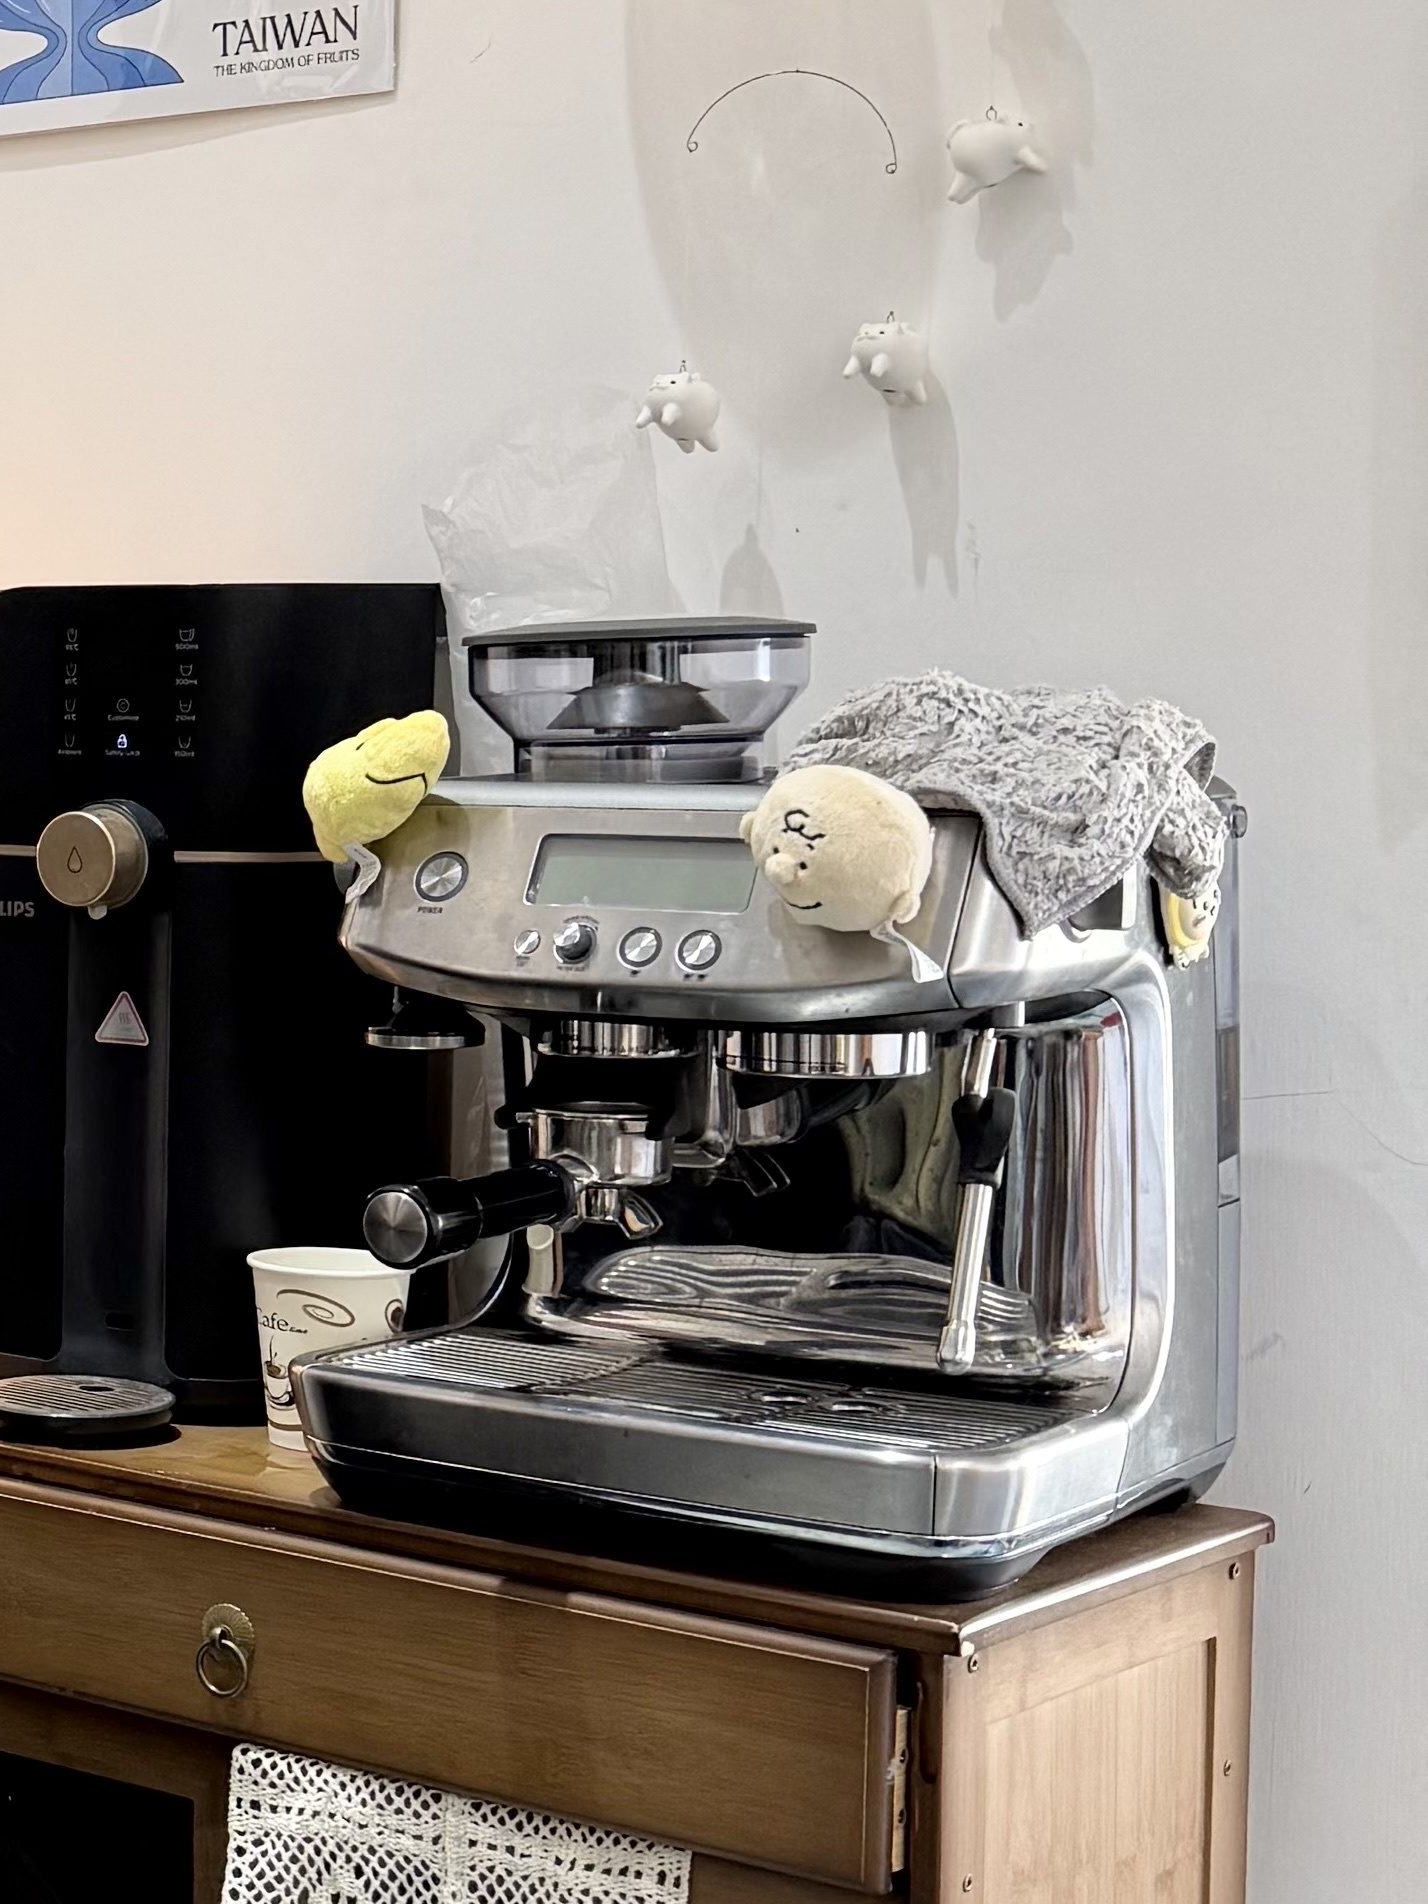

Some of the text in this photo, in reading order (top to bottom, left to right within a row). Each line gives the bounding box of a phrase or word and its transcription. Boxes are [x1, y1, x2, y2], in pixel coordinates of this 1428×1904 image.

[212, 5, 359, 57] TAIWAN
[213, 48, 360, 77] THE KINGDOM OF FRUITS
